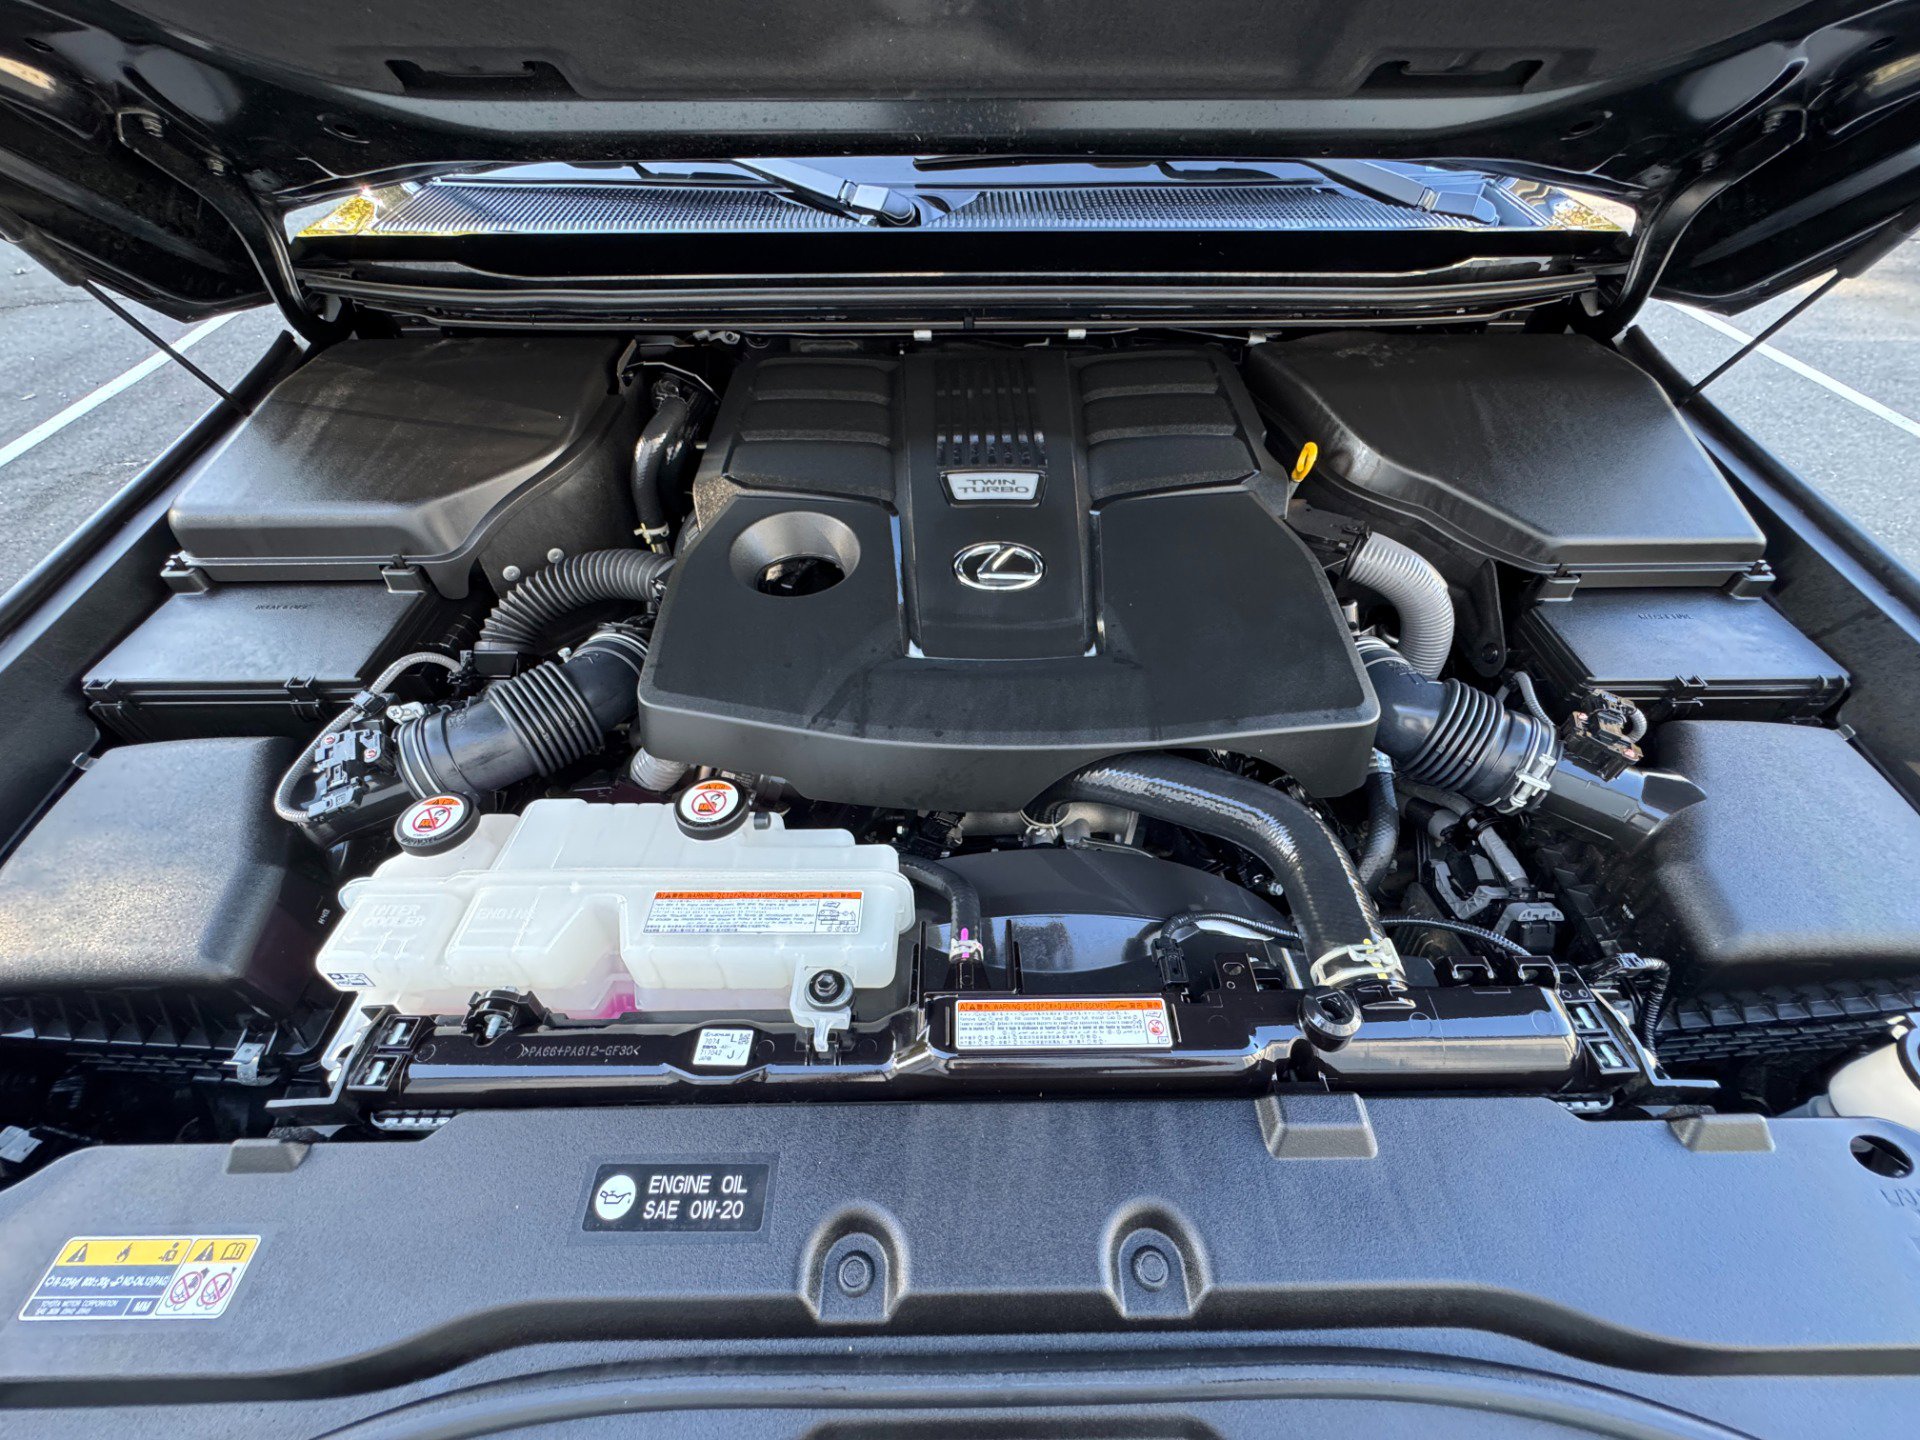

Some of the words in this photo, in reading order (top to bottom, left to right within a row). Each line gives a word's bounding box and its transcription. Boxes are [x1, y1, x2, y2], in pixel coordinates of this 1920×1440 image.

[966, 478, 1017, 486] TWIN
[957, 486, 1031, 494] TURBO
[361, 915, 427, 929] COOLER
[993, 1003, 1022, 1011] WARNING
[1064, 1002, 1111, 1010] AVERTISSEMENT
[648, 1174, 712, 1194] ENGINE
[721, 1174, 748, 1194] OIL
[642, 1200, 680, 1220] SAE
[689, 1200, 744, 1220] 0W-20
